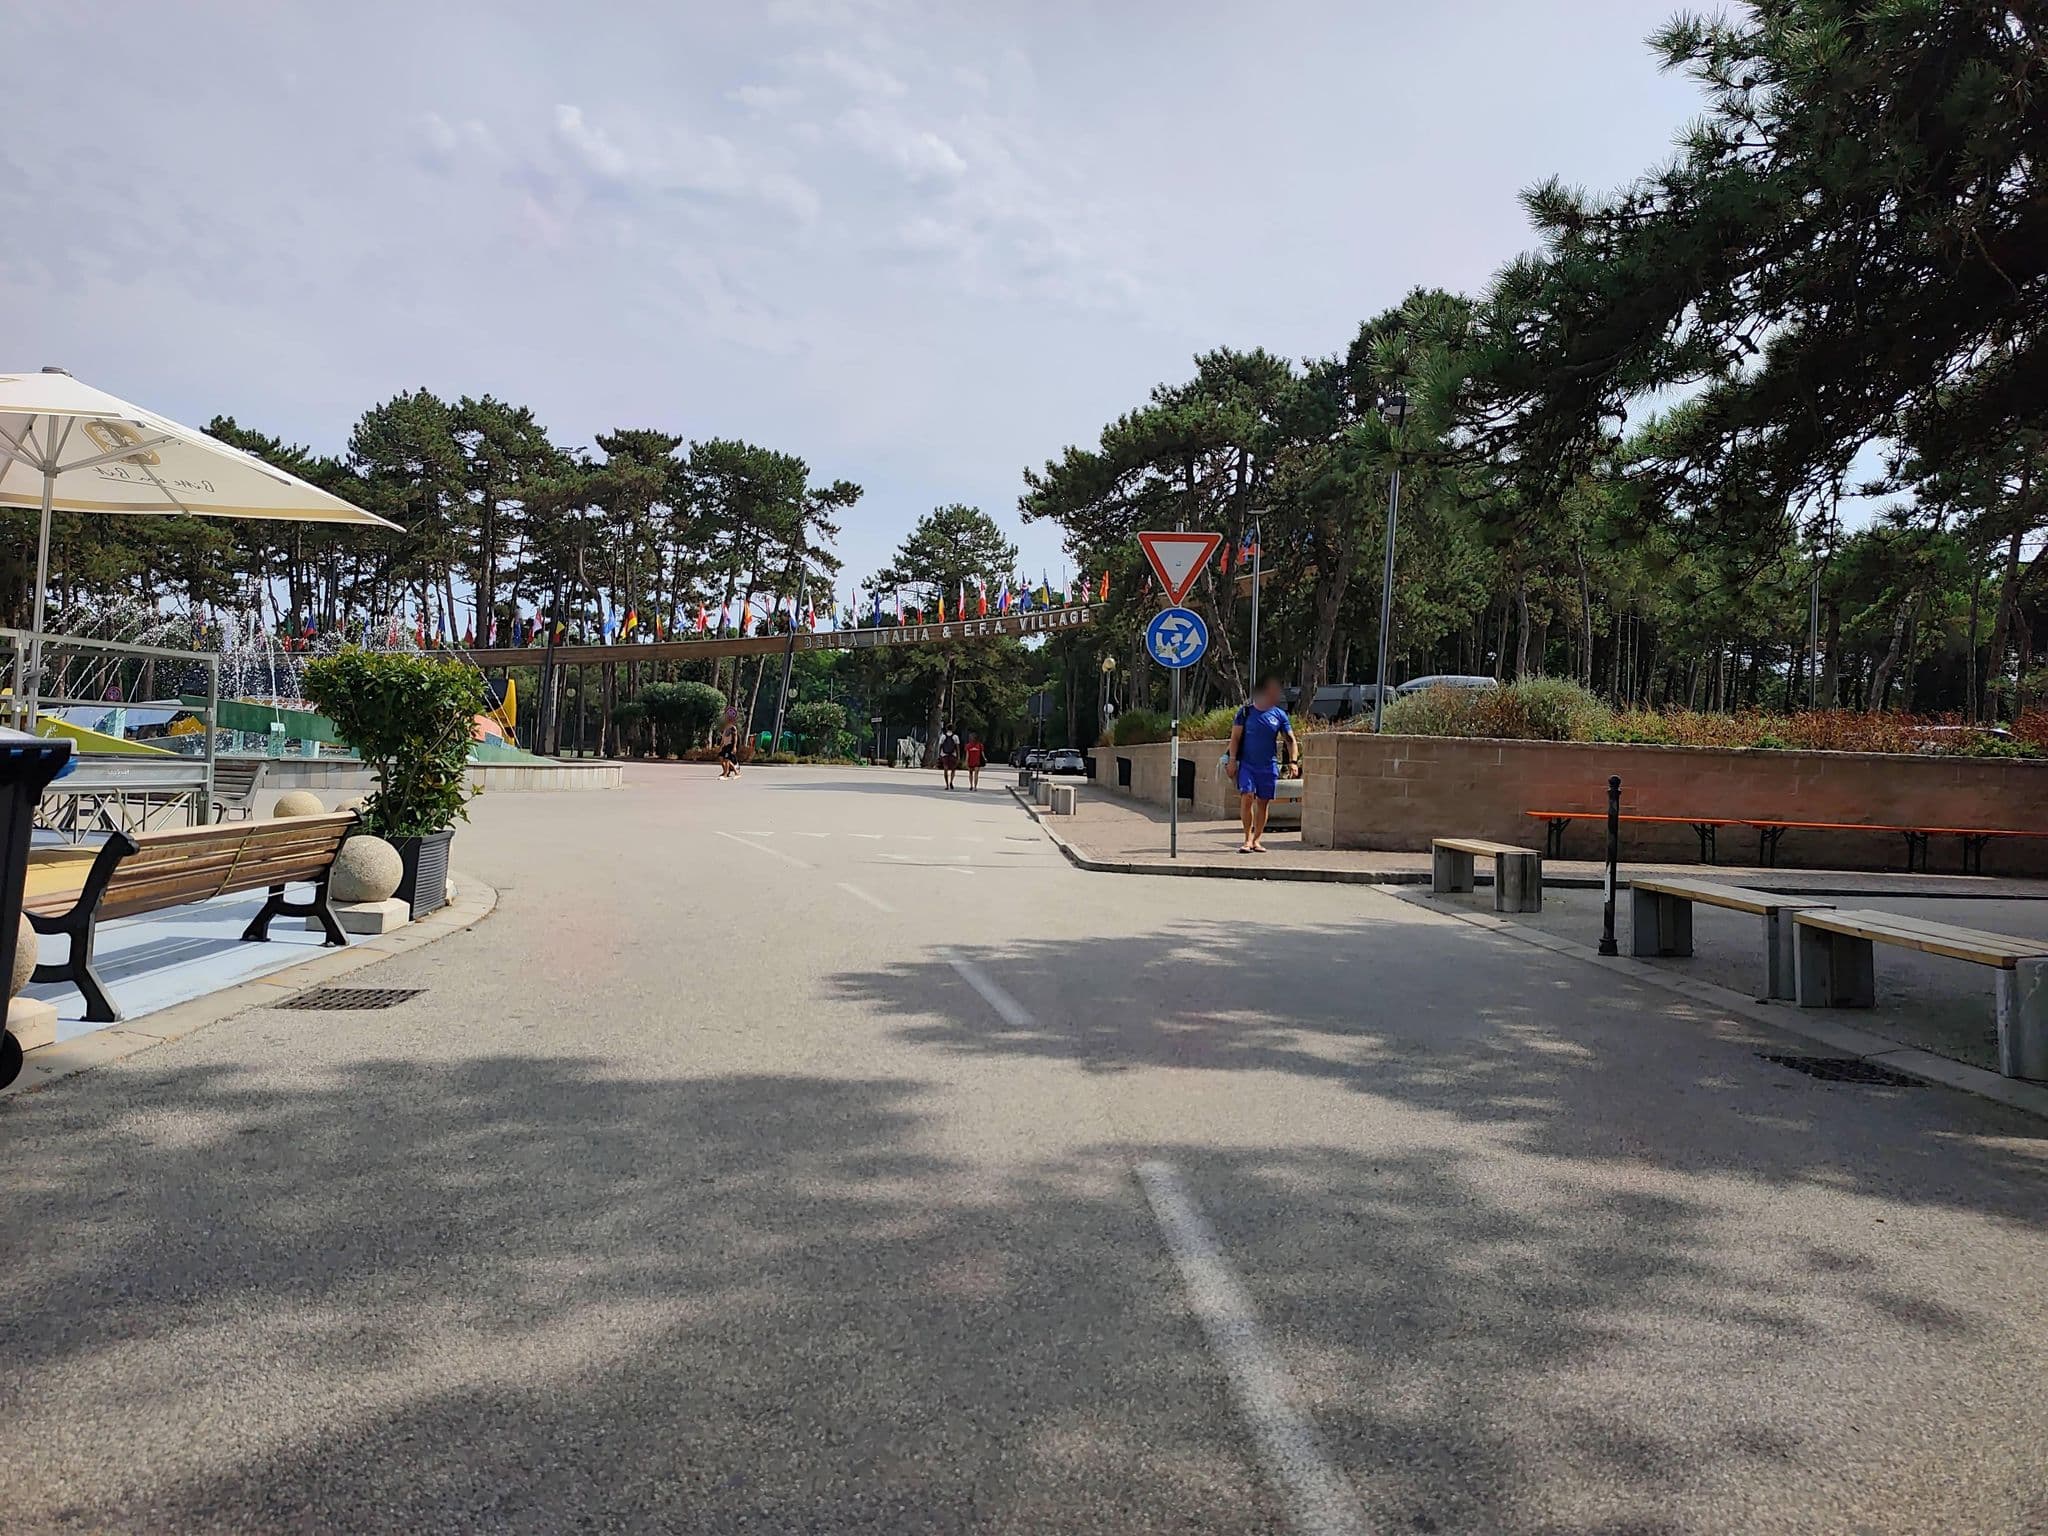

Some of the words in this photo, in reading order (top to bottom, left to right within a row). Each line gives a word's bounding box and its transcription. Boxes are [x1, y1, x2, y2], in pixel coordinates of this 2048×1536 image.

[803, 631, 859, 647] BELLA
[873, 626, 931, 645] ITALIA
[942, 625, 953, 639] &
[964, 621, 1007, 637] E.F.A.
[1019, 609, 1090, 631] VILLAGE
